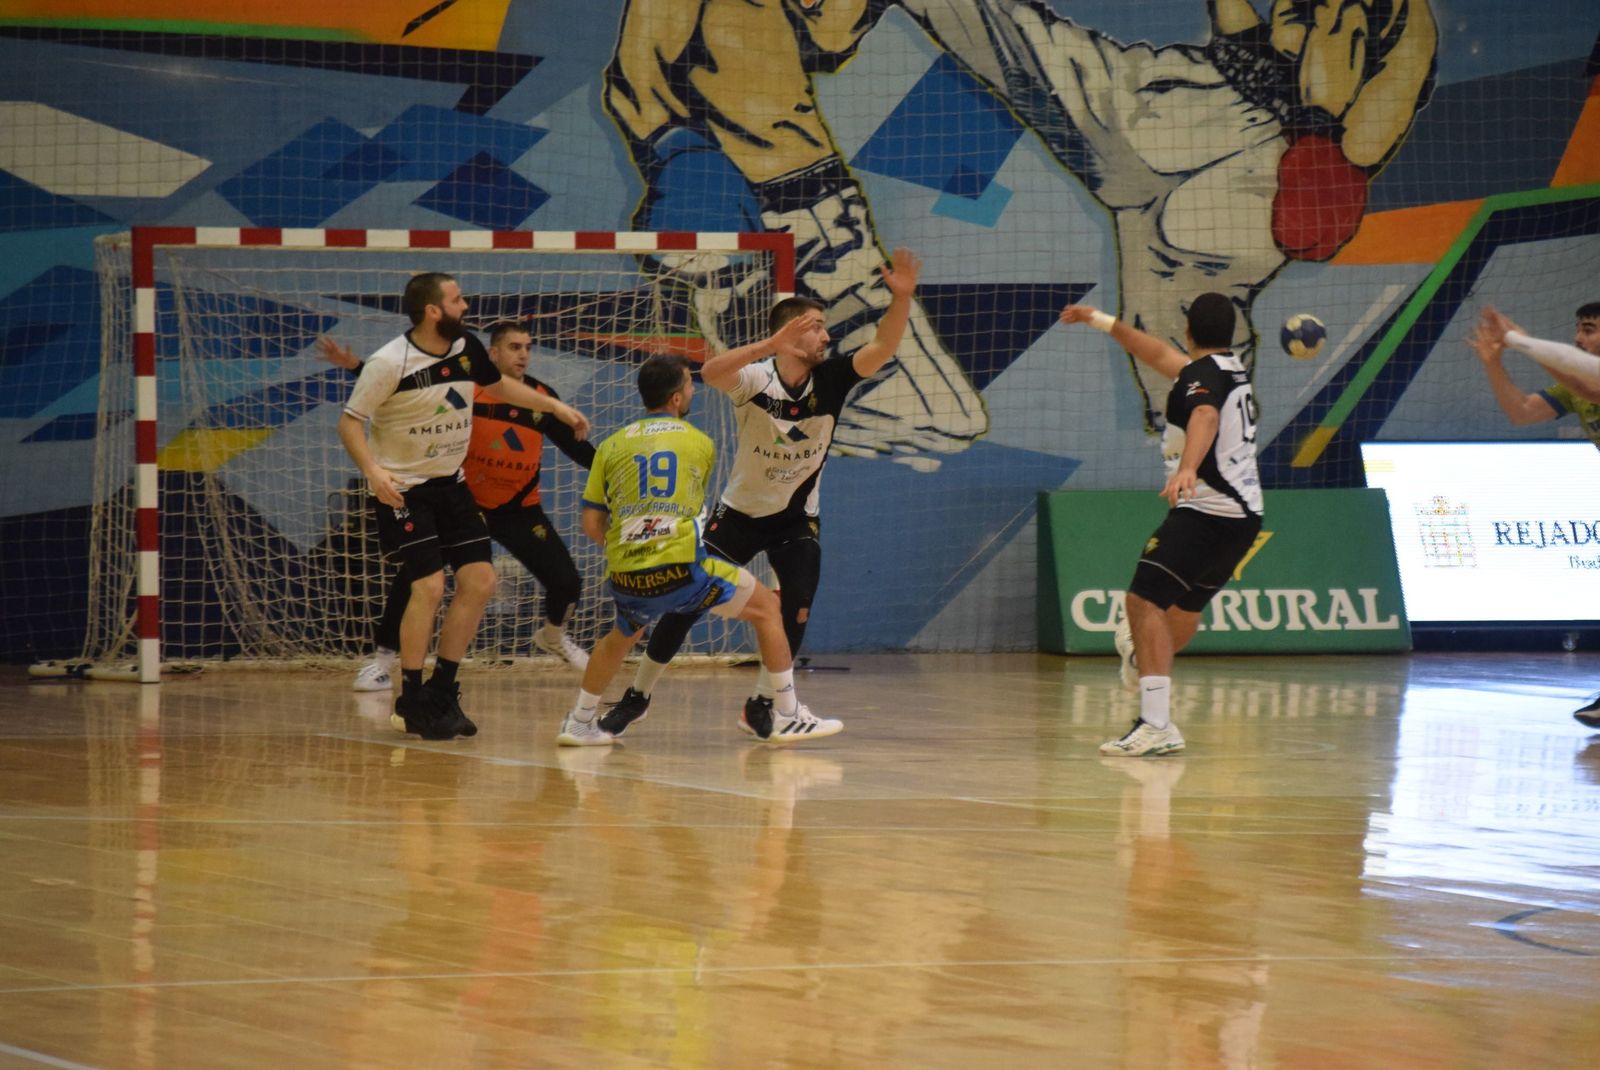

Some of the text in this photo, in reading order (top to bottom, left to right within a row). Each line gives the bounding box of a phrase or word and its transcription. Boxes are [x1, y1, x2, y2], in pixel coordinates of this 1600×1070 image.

[409, 418, 472, 435] AMENAB
[634, 451, 677, 499] 19
[1211, 588, 1400, 631] RURAL
